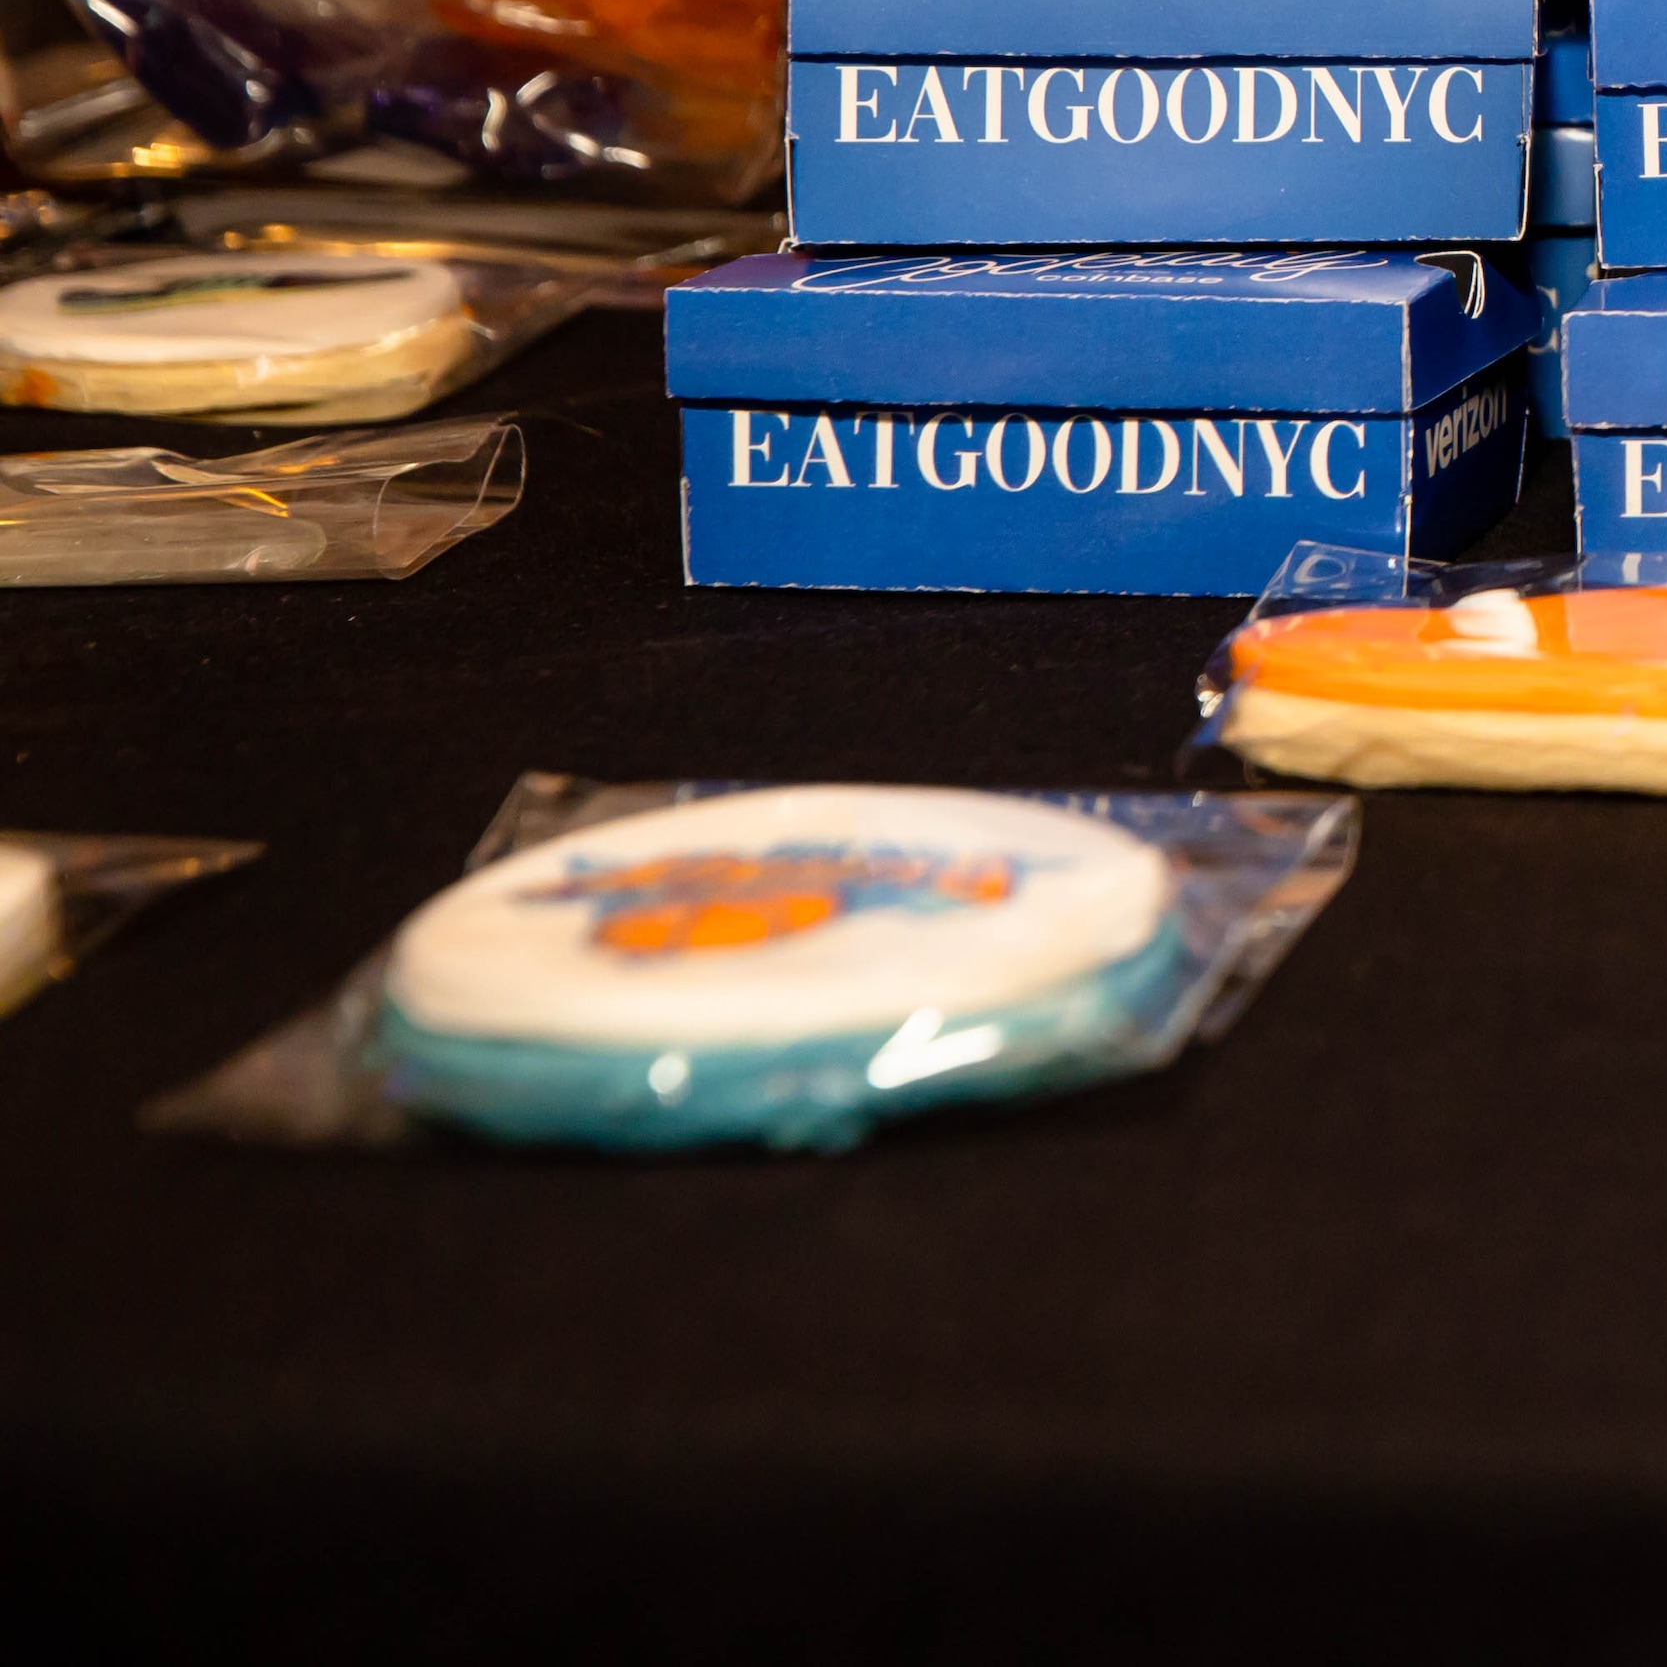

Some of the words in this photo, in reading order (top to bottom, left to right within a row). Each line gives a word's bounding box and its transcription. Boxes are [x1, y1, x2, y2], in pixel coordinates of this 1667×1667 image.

[835, 66, 1483, 145] EATGOODNYC
[1035, 273, 1224, 284] coinbase
[727, 409, 1367, 500] EATGOODNYC
[1425, 384, 1507, 479] verizon
